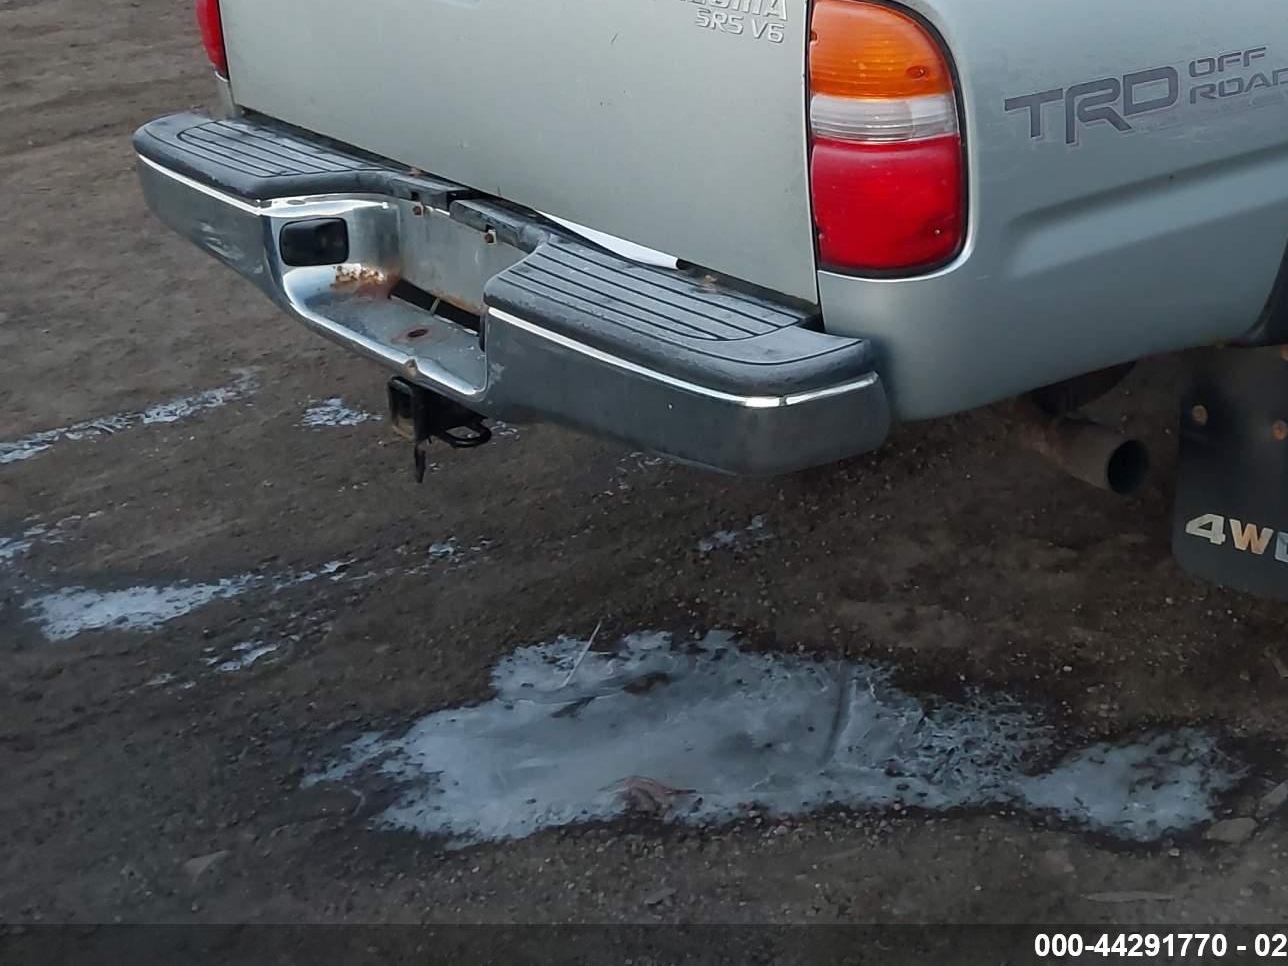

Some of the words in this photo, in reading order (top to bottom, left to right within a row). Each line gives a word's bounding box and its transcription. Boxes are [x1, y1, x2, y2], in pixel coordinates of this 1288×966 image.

[695, 7, 744, 35] SR5
[751, 17, 785, 43] V6
[1188, 46, 1267, 78] OFF
[1004, 65, 1179, 144] TRD
